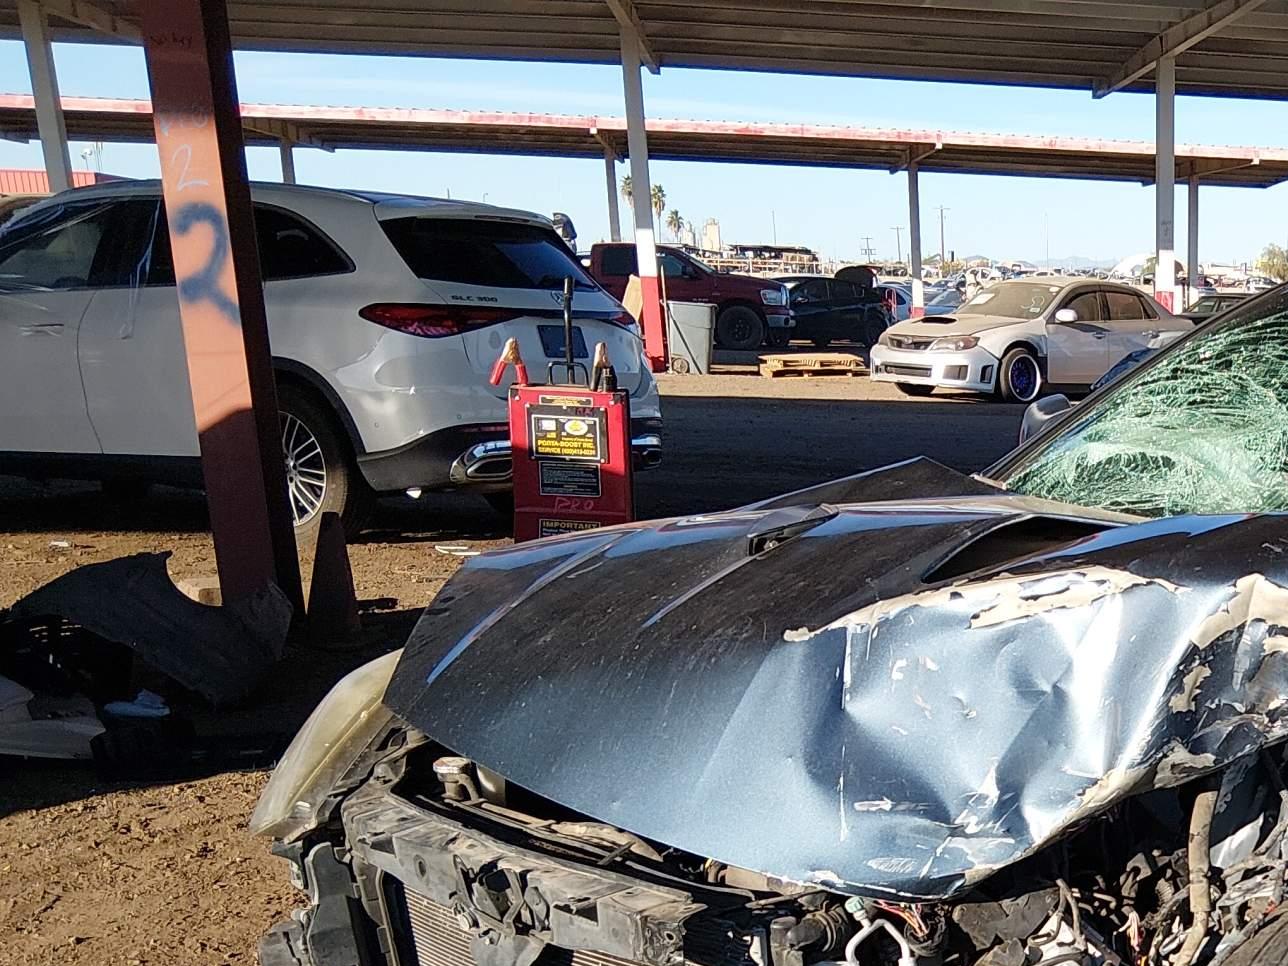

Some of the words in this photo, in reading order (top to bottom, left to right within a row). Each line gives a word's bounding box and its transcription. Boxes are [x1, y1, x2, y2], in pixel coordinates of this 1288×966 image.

[171, 143, 209, 192] 2
[171, 202, 241, 328] 2
[542, 521, 598, 530] IMPORTANT
